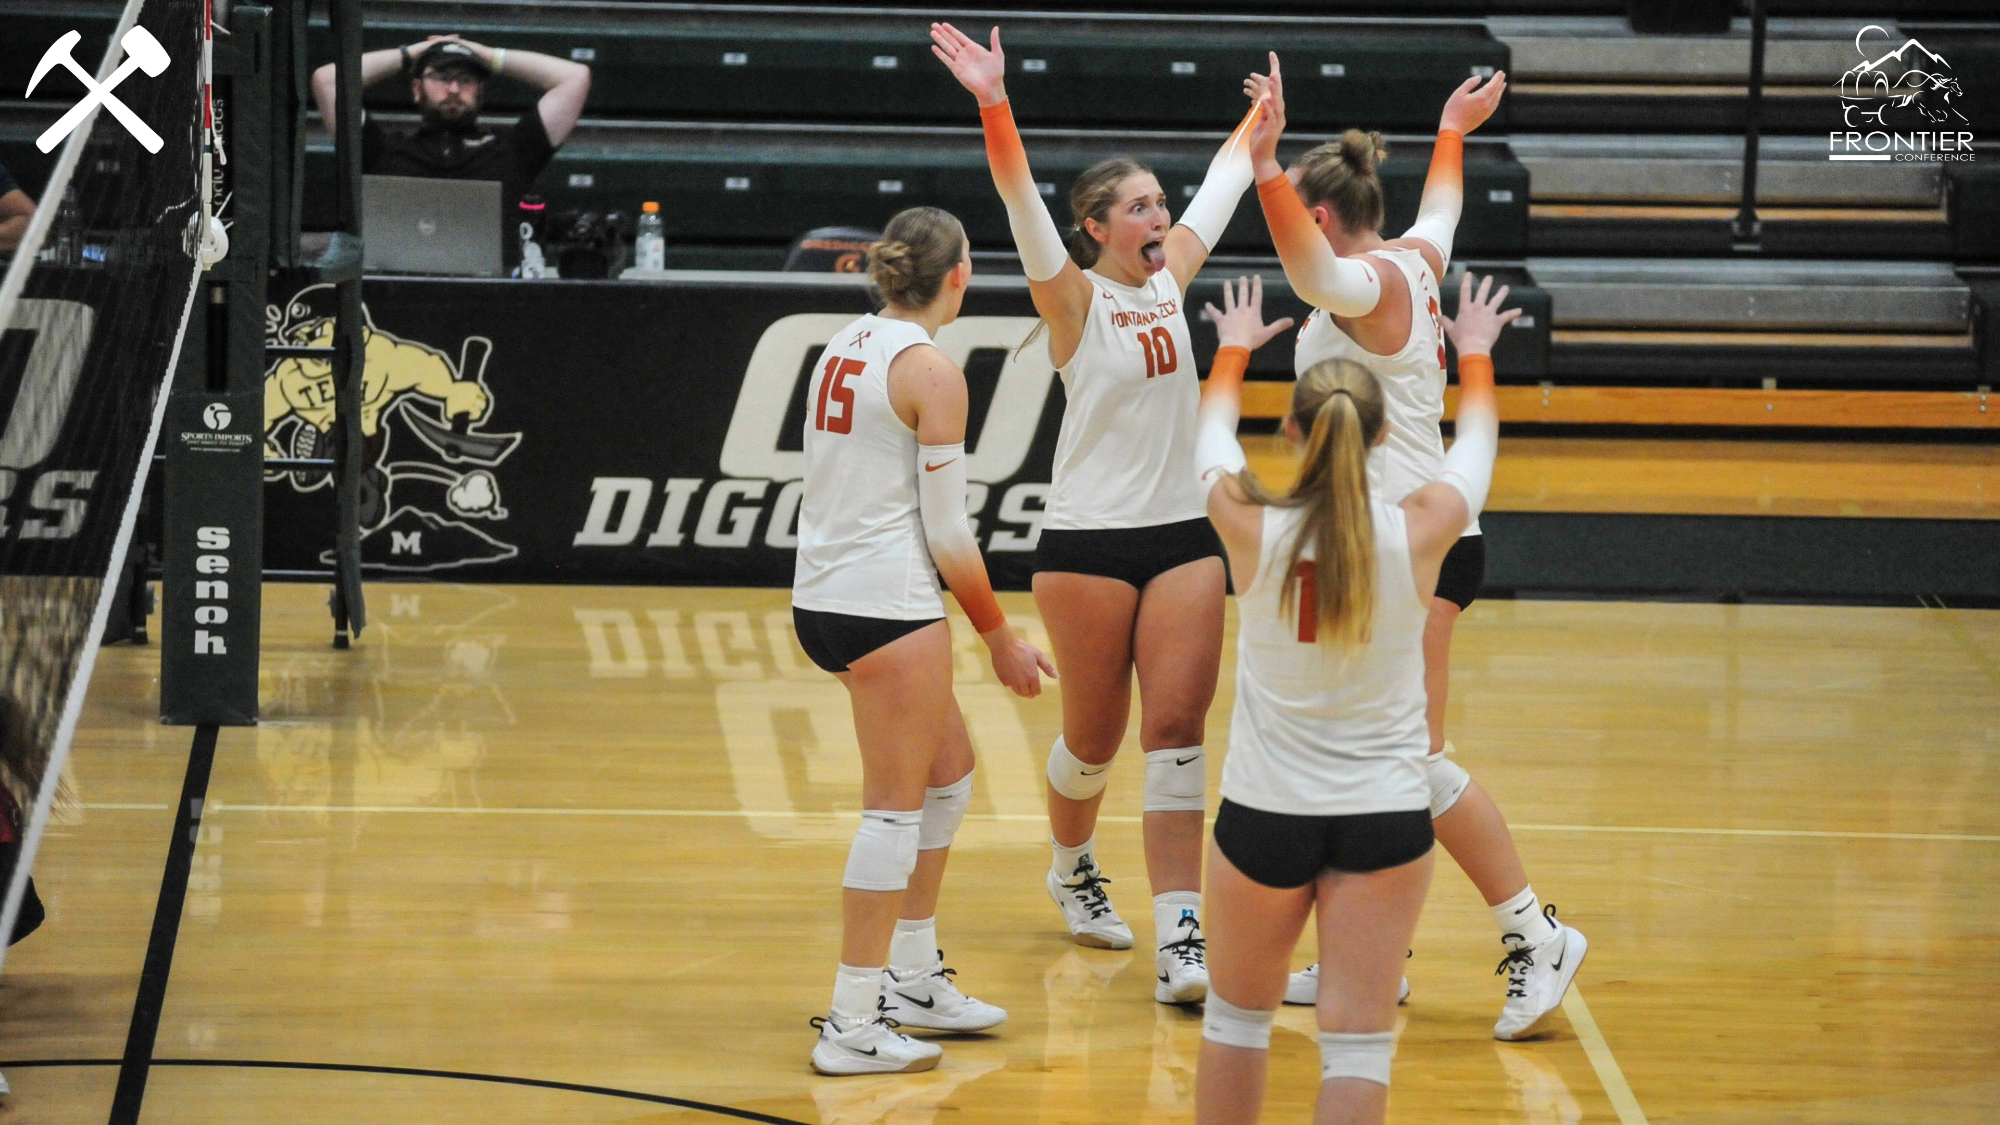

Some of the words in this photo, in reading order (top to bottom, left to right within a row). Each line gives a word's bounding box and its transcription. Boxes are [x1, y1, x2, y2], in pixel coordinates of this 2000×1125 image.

[1136, 326, 1178, 379] 10
[815, 355, 868, 435] 15
[391, 530, 422, 555] M
